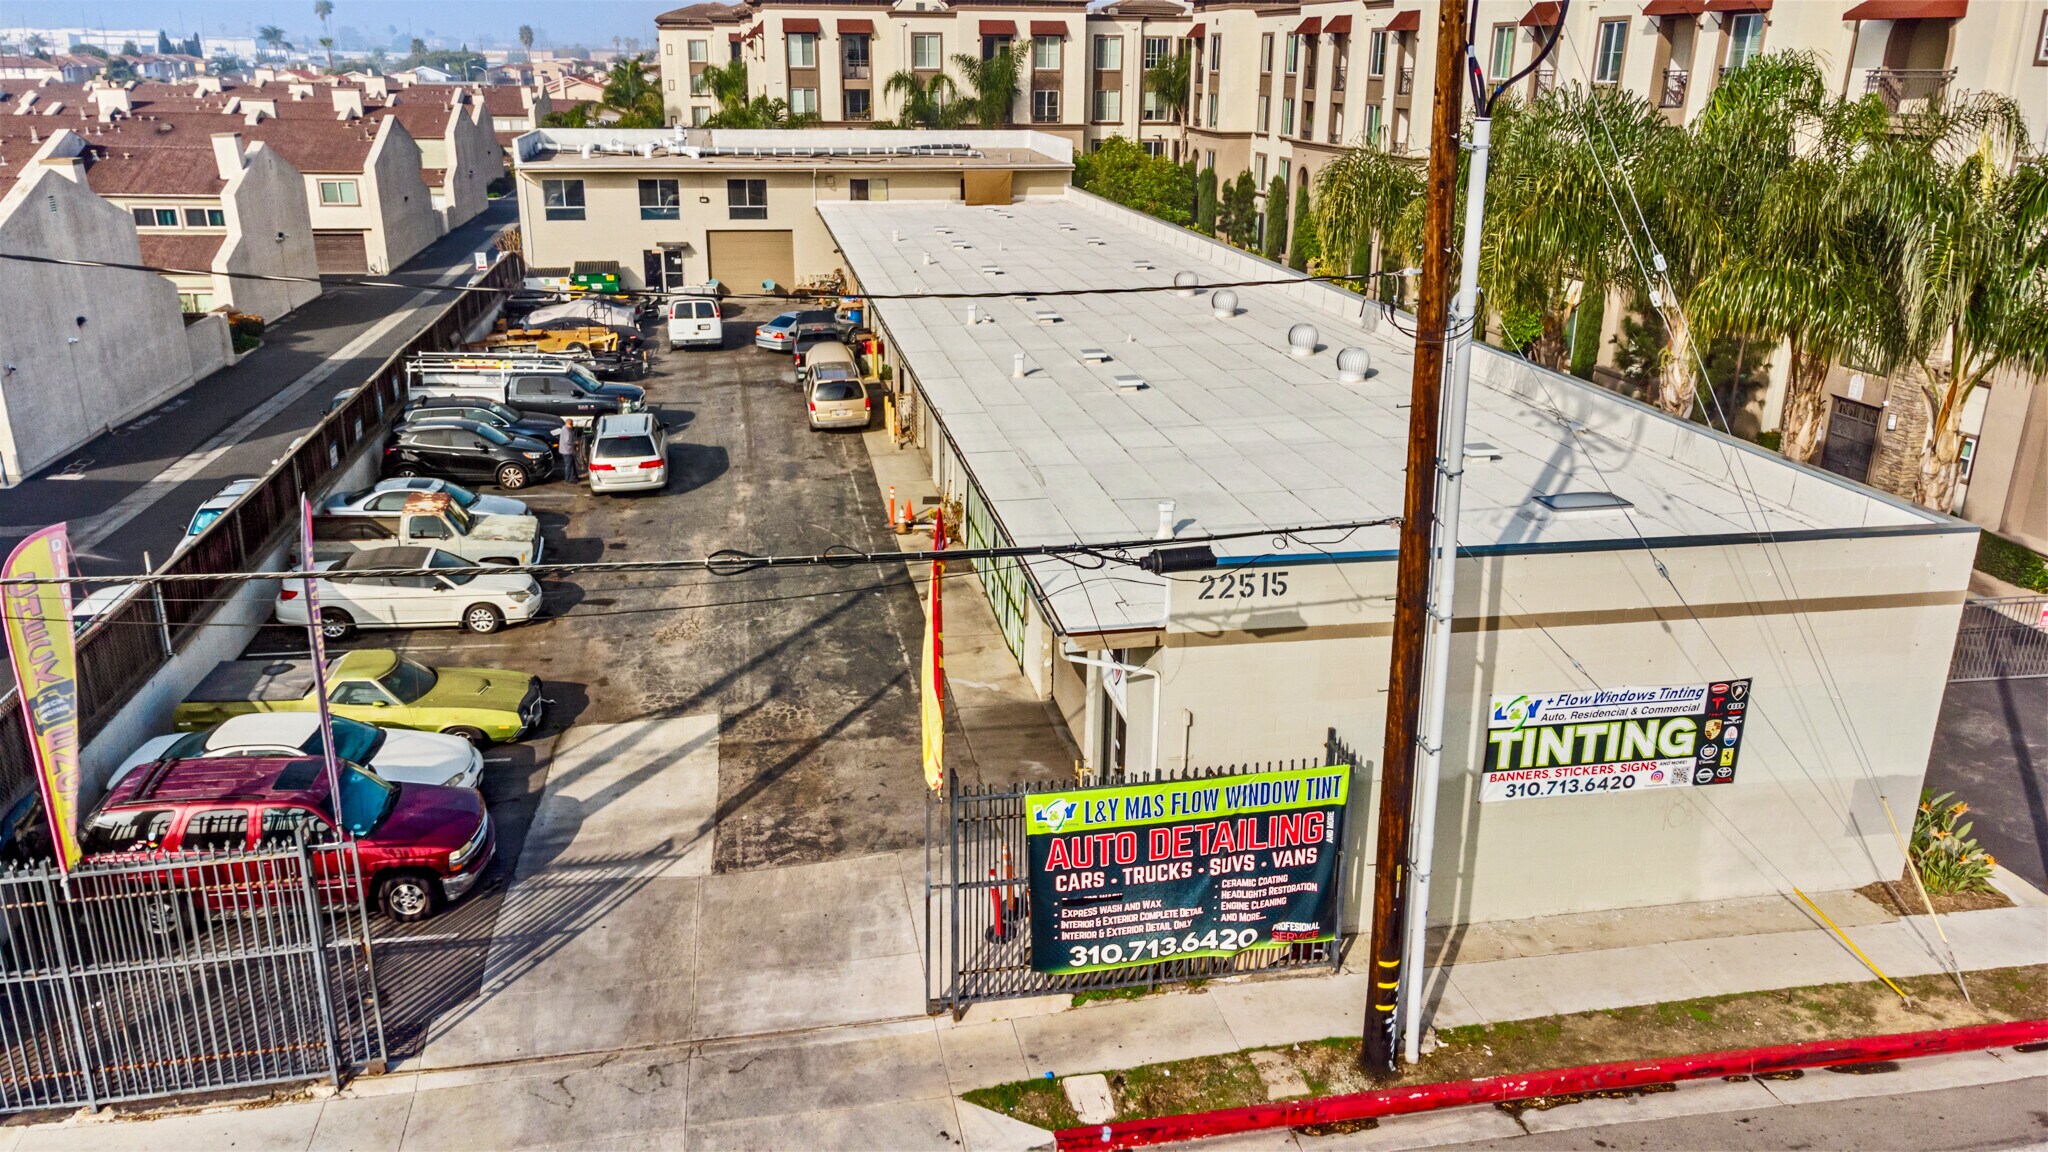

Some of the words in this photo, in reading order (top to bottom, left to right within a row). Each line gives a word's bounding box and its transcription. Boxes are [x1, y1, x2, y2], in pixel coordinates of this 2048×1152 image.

[1198, 571, 1288, 600] 22515
[1556, 693, 1592, 706] Flow
[1593, 690, 1656, 704] Windows
[1660, 686, 1705, 700] Tinting
[1541, 713, 1567, 722] Auto,
[1570, 707, 1629, 720] Residencial
[1630, 707, 1638, 715] &
[1641, 703, 1700, 715] Commercial
[1489, 716, 1698, 770] TINTING
[1620, 761, 1657, 773] SIGNS
[1505, 774, 1635, 798] 310.713.6420
[1084, 797, 1119, 825] L&Y
[1124, 793, 1165, 821] MAS
[1171, 787, 1220, 816] FLOW
[1225, 779, 1300, 810] WINDOW
[1306, 774, 1342, 801] TINT
[1326, 811, 1335, 828] MORE
[1044, 830, 1138, 872] AUTO
[1148, 810, 1325, 862] DETAILING
[1326, 829, 1334, 843] AND
[1055, 871, 1105, 892] CARS
[1122, 862, 1193, 886] TRUCKS
[1209, 854, 1256, 876] SUVS
[1272, 847, 1318, 868] VANS
[1220, 888, 1267, 900] HEADLIGHTS
[1268, 882, 1318, 896] RESTORATION
[1221, 877, 1257, 889] CERAMIC
[1257, 874, 1288, 886] COATING
[1061, 906, 1098, 919] EXPRESS
[1100, 903, 1123, 914] WASH
[1124, 902, 1141, 912] AND
[1142, 900, 1162, 909] WAX
[1220, 901, 1249, 911] ENGINE
[1251, 896, 1287, 910] CLEANING
[1060, 918, 1095, 930] INTERIOR
[1095, 917, 1102, 927] &
[1102, 913, 1138, 927] EXTERIOR
[1139, 909, 1179, 921] COMPLETE
[1179, 906, 1204, 918] DETAIL
[1220, 913, 1238, 922] AND
[1271, 921, 1320, 932] PROFESIONAL
[1061, 930, 1098, 941] INTERIOR
[1098, 928, 1105, 939] &
[1106, 925, 1144, 938] EXTERIOR
[1145, 920, 1172, 932] DETAIL
[1173, 919, 1193, 929] ONLY
[1271, 930, 1319, 942] SERVICE
[1069, 928, 1258, 967] 310.713.6420
